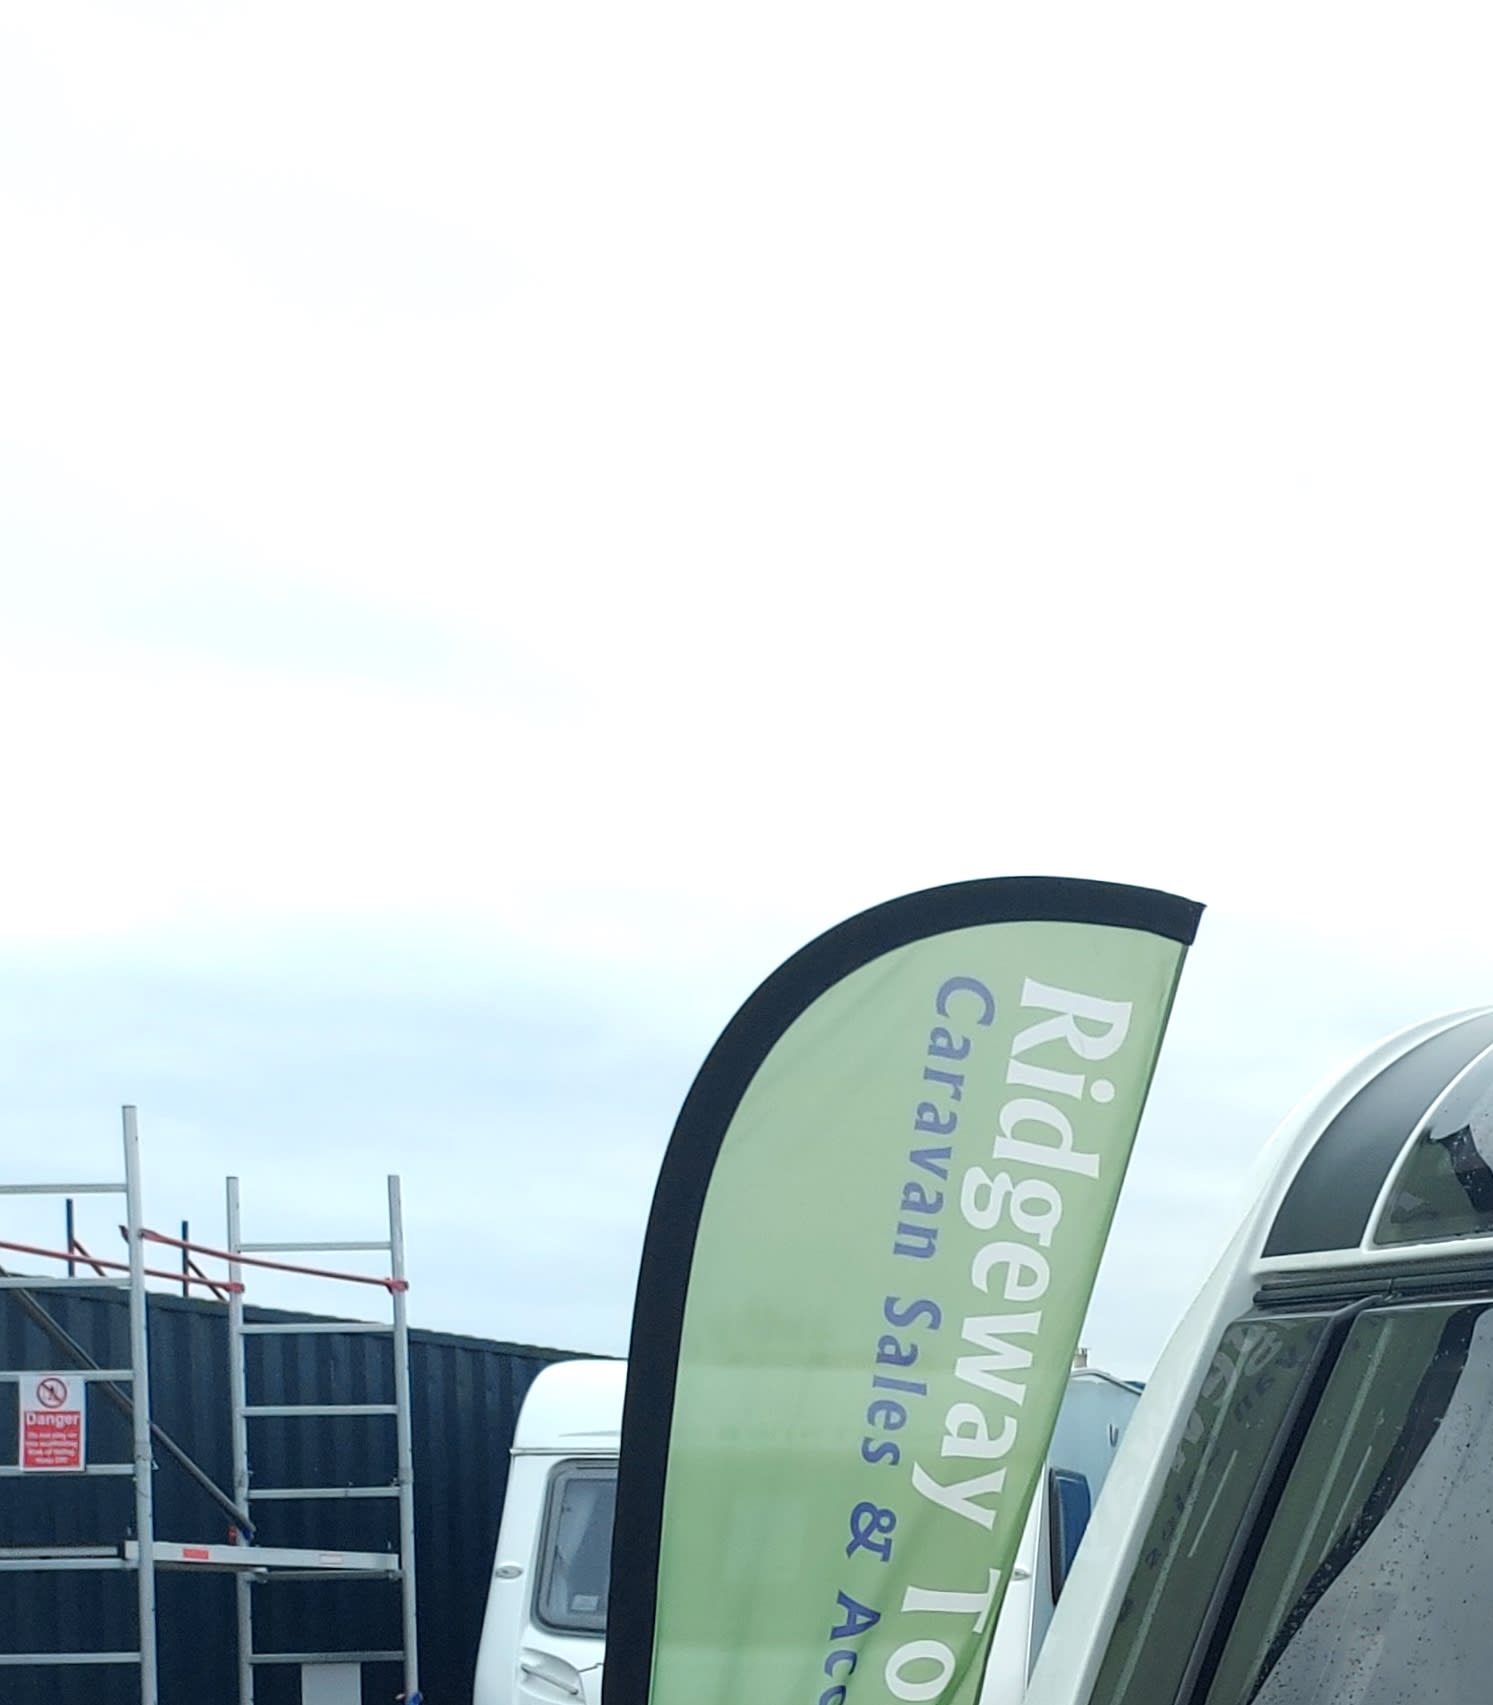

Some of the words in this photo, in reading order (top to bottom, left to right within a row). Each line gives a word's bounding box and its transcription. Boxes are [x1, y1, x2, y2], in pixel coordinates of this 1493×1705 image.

[892, 975, 996, 1259] Caravan
[911, 976, 1133, 1530] Ridgeway
[26, 1412, 80, 1429] Danger
[861, 1295, 942, 1467] Sales
[845, 1501, 897, 1563] &
